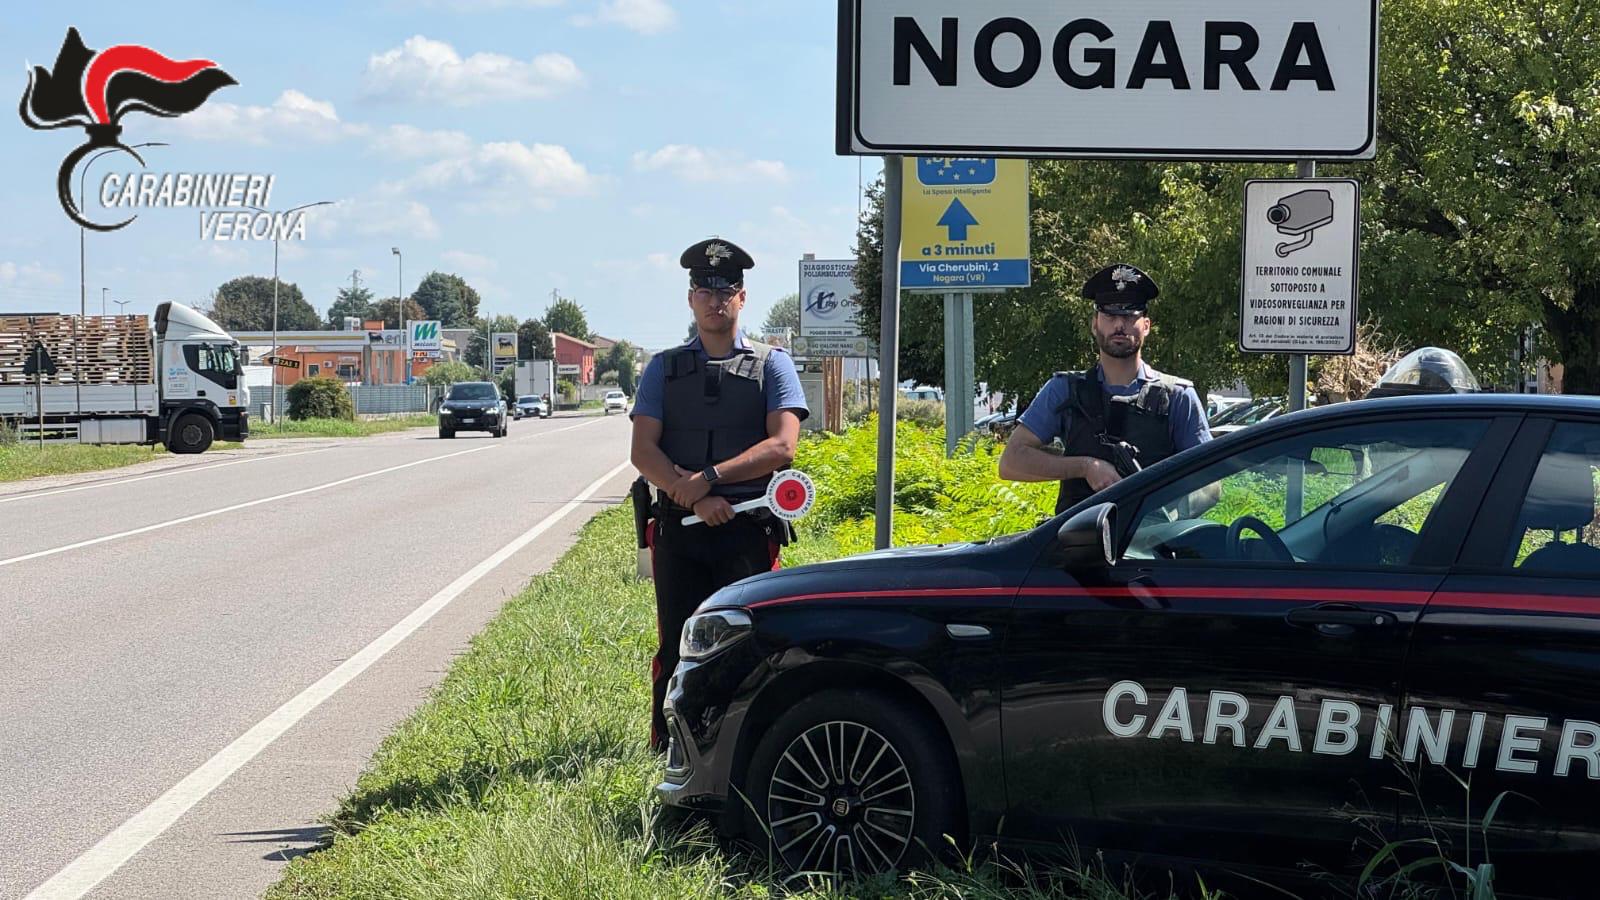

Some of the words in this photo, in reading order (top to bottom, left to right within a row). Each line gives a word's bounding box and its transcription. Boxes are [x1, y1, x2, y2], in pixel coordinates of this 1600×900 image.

[892, 16, 1336, 91] NOGARA
[922, 247, 931, 256] a
[934, 244, 942, 256] 3
[945, 242, 996, 256] minuti
[919, 263, 936, 272] Via
[938, 262, 991, 272] Cherubini,
[992, 262, 1000, 272] 2
[1256, 266, 1298, 276] TERRITORIO
[1302, 266, 1342, 276] COMUNALE
[933, 274, 964, 284] Nogara
[966, 272, 985, 282] (VR)
[1270, 283, 1317, 292] SOTTOPOSTO
[1320, 283, 1325, 292] A
[1250, 299, 1328, 310] VIDEOSORVEGLIANZA
[1331, 300, 1346, 310] PER
[1254, 316, 1285, 326] RAGIONI
[1288, 316, 1296, 326] DI
[1299, 316, 1340, 326] SICUREZZA
[385, 331, 407, 344] eni
